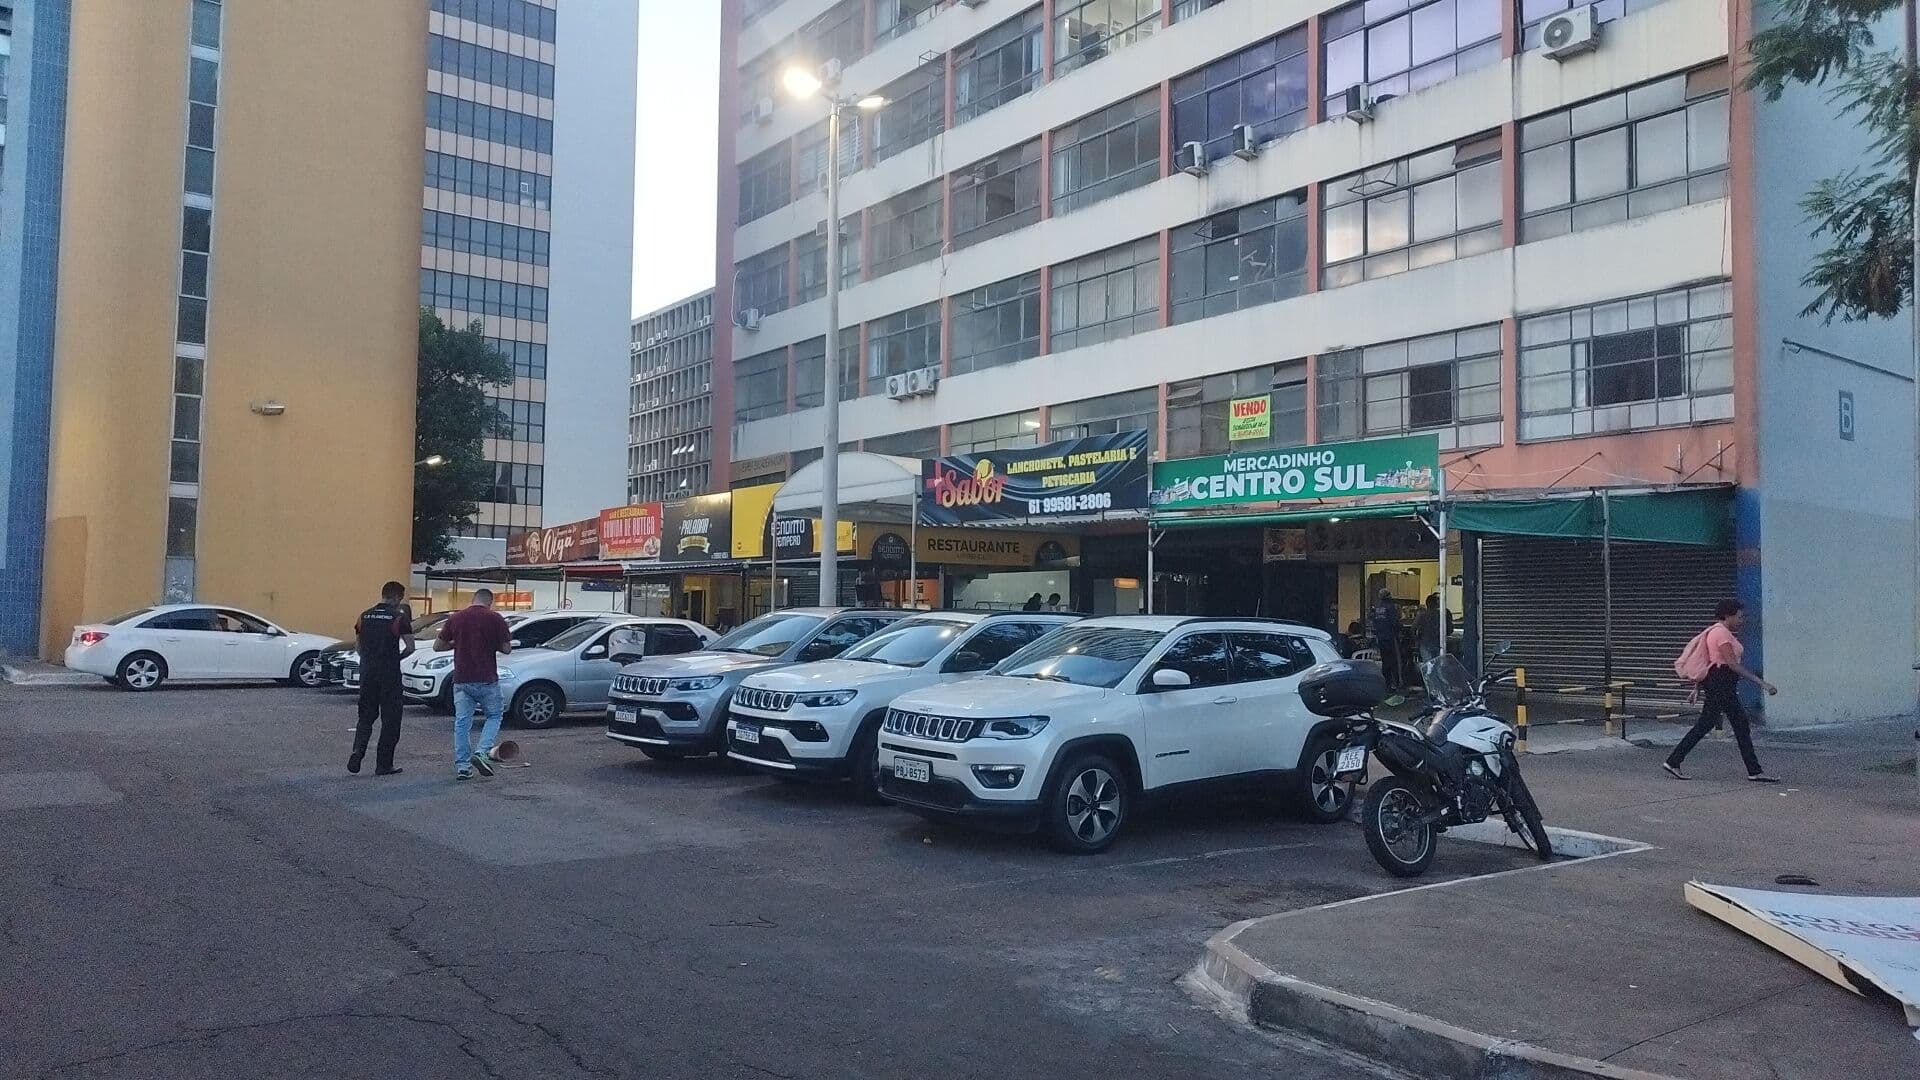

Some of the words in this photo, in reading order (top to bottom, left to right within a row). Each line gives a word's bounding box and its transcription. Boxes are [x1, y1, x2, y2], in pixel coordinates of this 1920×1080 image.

[1233, 400, 1267, 417] VENDO
[1841, 397, 1852, 433] B
[1006, 456, 1066, 474] LANCHONETE,
[1068, 448, 1126, 467] PASTELARIA
[1129, 447, 1137, 460] E
[1224, 450, 1335, 473] MERCADINHO
[1041, 471, 1096, 488] PETISCARIA
[1191, 467, 1305, 500] CENTRO
[1314, 464, 1375, 492] SUL
[1029, 499, 1040, 514] 61
[1043, 493, 1111, 513] 99581-2806
[543, 529, 575, 561] Olga
[927, 539, 1021, 554] RESTAURANTE
[909, 767, 927, 780] 8573
